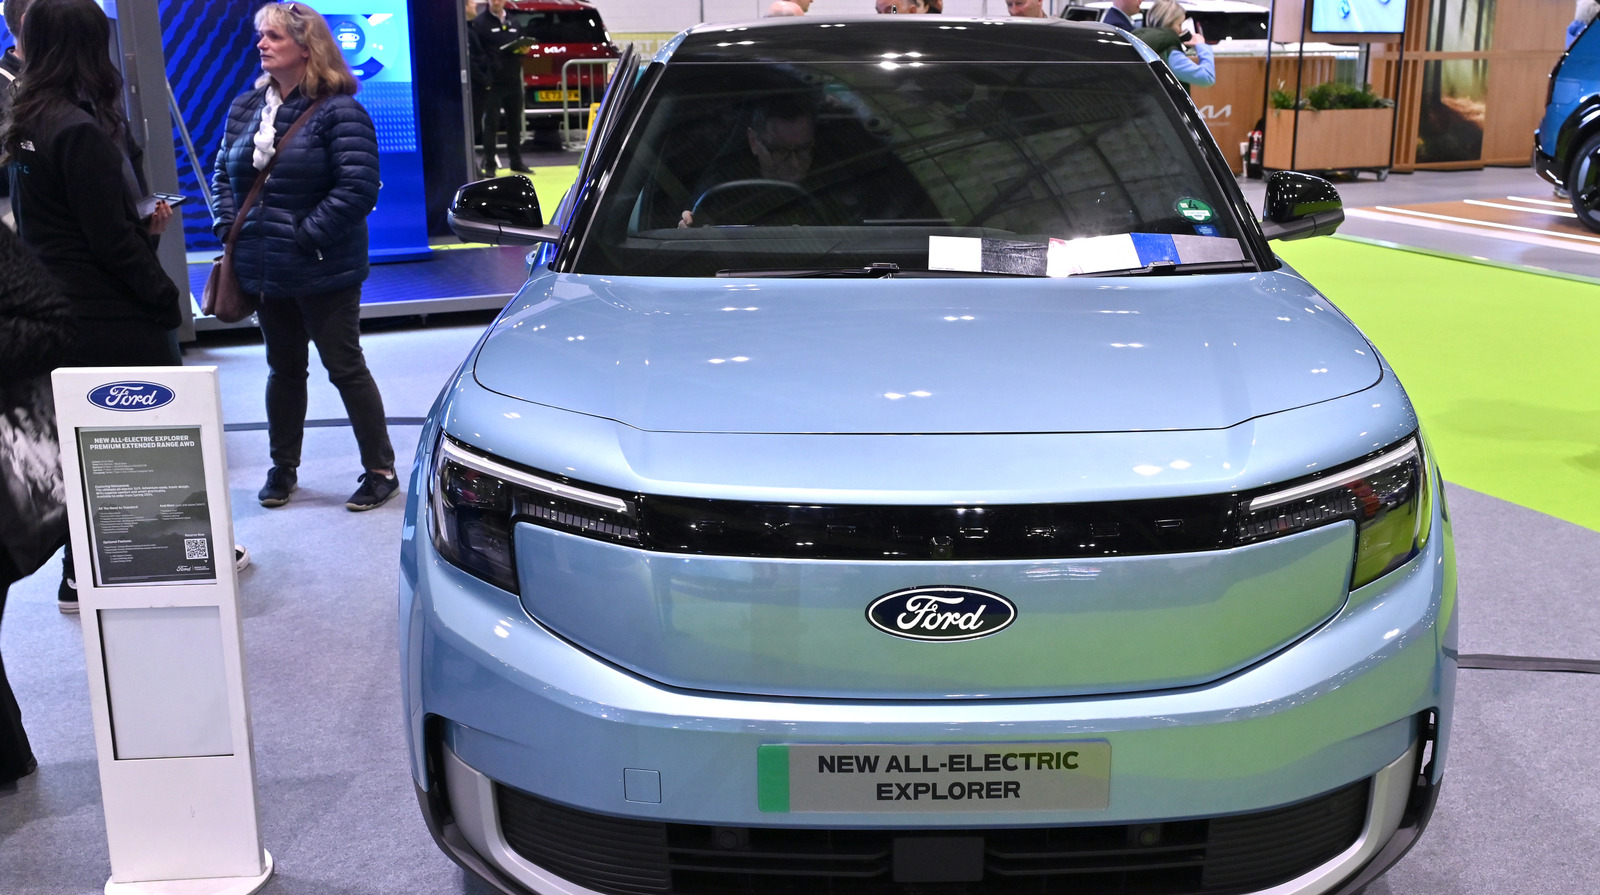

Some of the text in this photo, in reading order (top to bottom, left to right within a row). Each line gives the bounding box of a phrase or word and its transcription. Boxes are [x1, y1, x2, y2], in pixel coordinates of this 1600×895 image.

[105, 385, 158, 406] Ford
[896, 595, 987, 630] Ford
[818, 751, 1079, 773] NEW ALL-ELECTRIC
[876, 781, 1021, 801] EXPLORER
